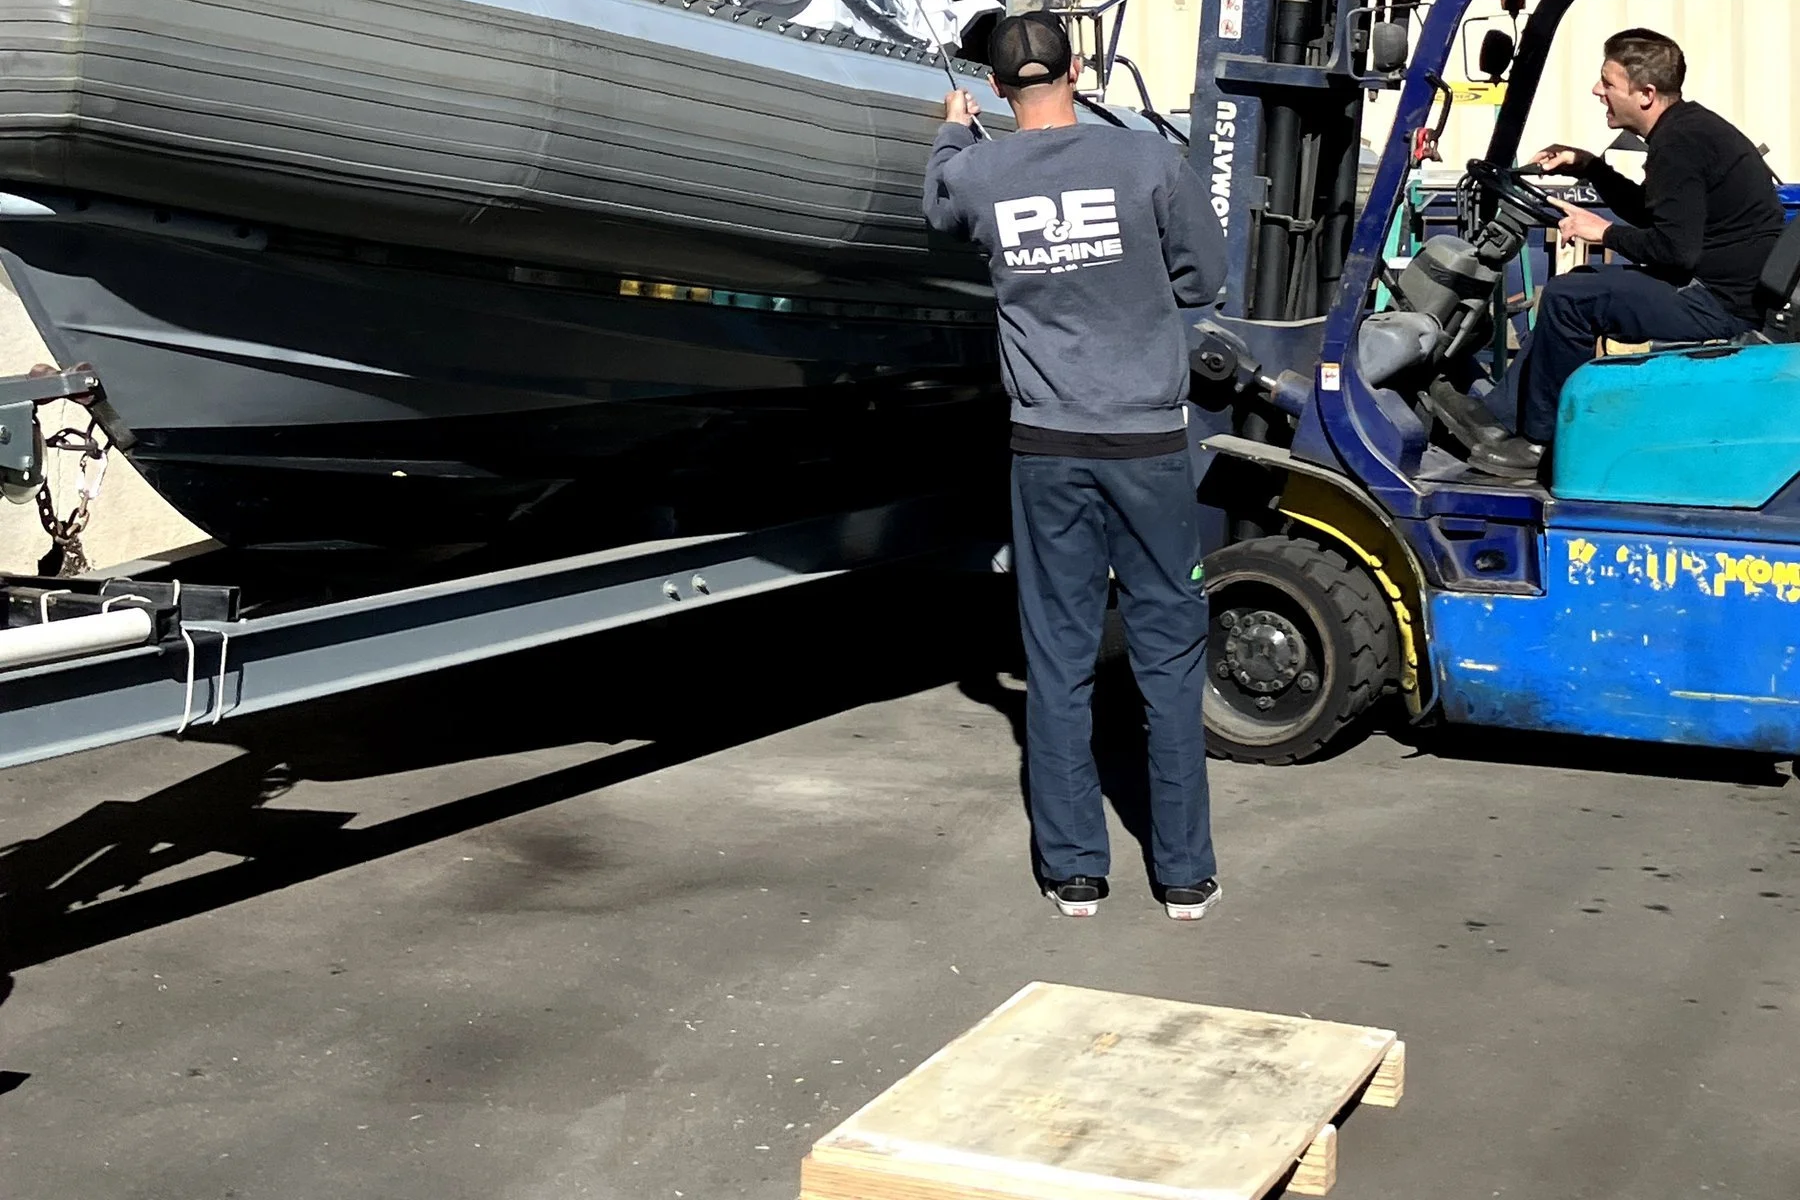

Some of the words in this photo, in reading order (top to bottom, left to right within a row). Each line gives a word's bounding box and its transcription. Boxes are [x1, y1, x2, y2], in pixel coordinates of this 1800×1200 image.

[1208, 100, 1238, 238] OMATSU
[993, 187, 1121, 249] P&E
[1003, 237, 1124, 267] MARINE
